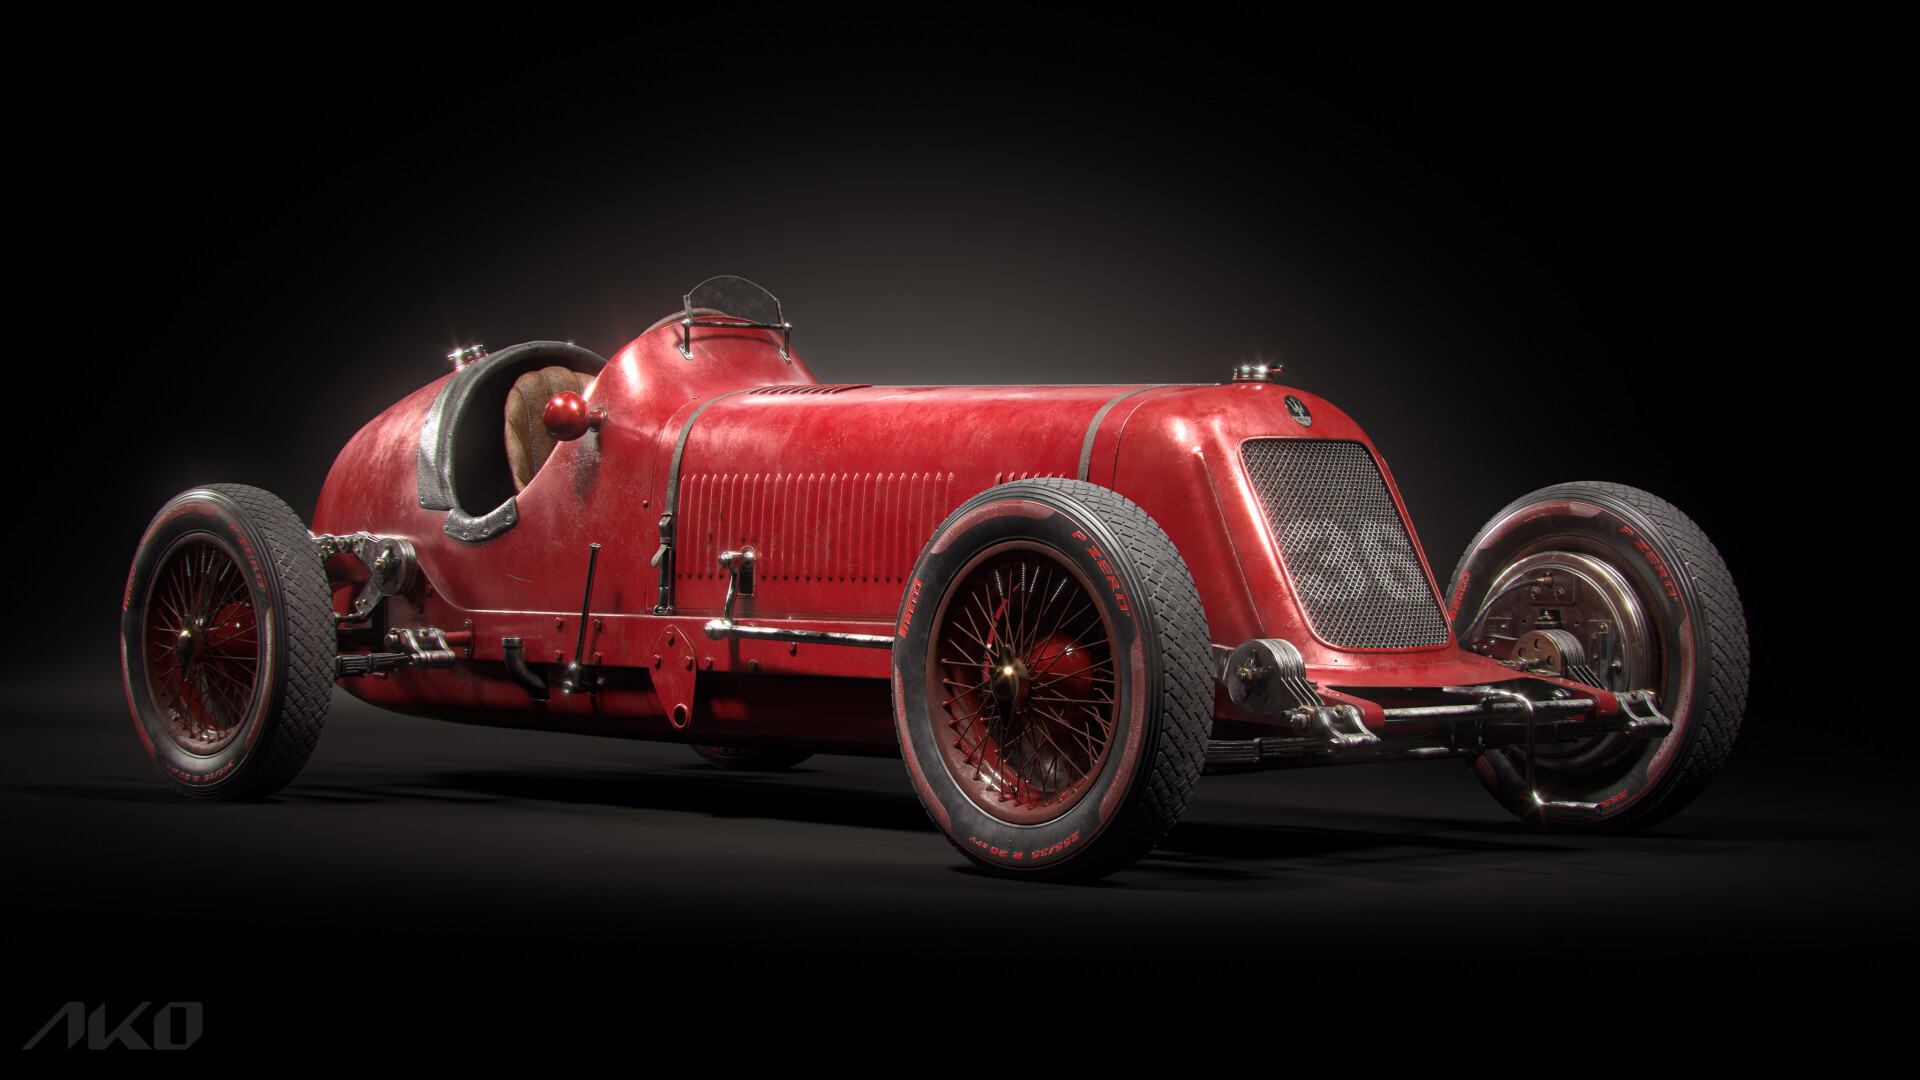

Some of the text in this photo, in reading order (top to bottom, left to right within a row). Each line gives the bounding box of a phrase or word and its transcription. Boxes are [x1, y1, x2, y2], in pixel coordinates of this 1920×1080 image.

[1071, 530, 1129, 611] P ZERO
[1619, 526, 1678, 596] P ZERO
[989, 847, 1009, 858] 20
[1012, 851, 1024, 860] R
[1031, 830, 1080, 860] 255/35
